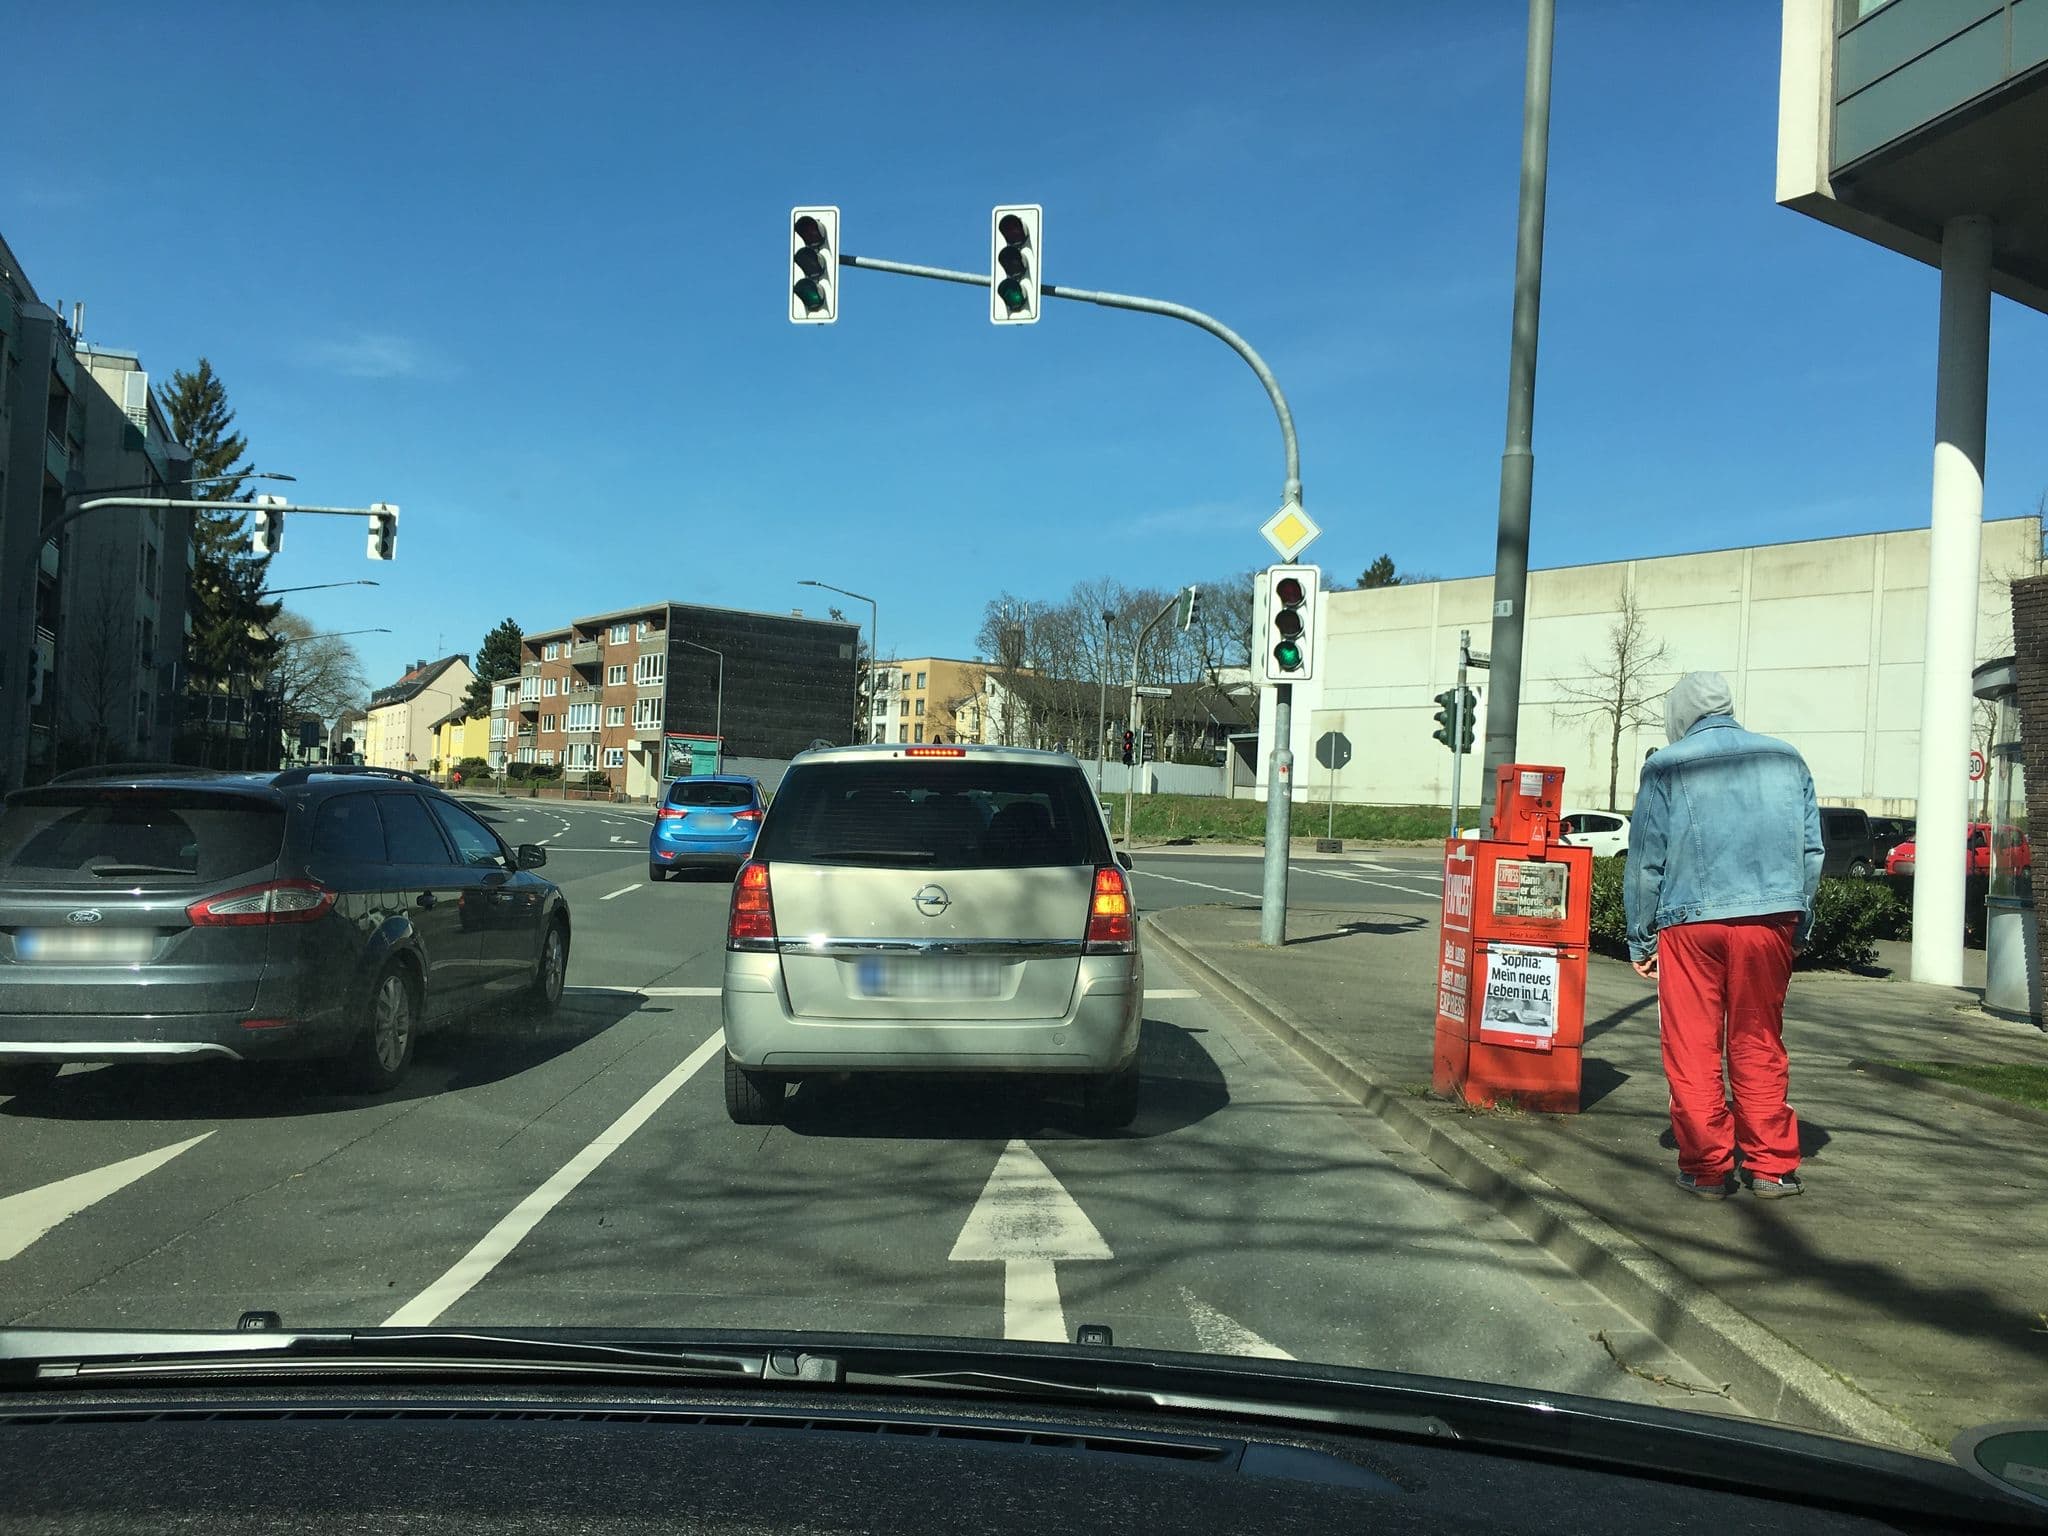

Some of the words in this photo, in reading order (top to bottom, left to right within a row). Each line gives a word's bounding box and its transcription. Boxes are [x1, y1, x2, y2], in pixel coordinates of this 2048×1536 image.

[1499, 867, 1519, 882] EXPRESS
[1520, 874, 1540, 885] Kann
[1447, 874, 1470, 917] EXPRESS
[1520, 887, 1529, 895] er
[1519, 896, 1544, 906] Morde
[1445, 939, 1455, 959] Bei
[1501, 953, 1542, 969] Sophia:
[1492, 968, 1516, 982] Mein
[1519, 971, 1551, 985] neues
[1488, 983, 1519, 998] Leben
[1521, 986, 1531, 1000] in
[1533, 987, 1552, 1001] L.A.
[1440, 990, 1465, 1017] EXPRESS
